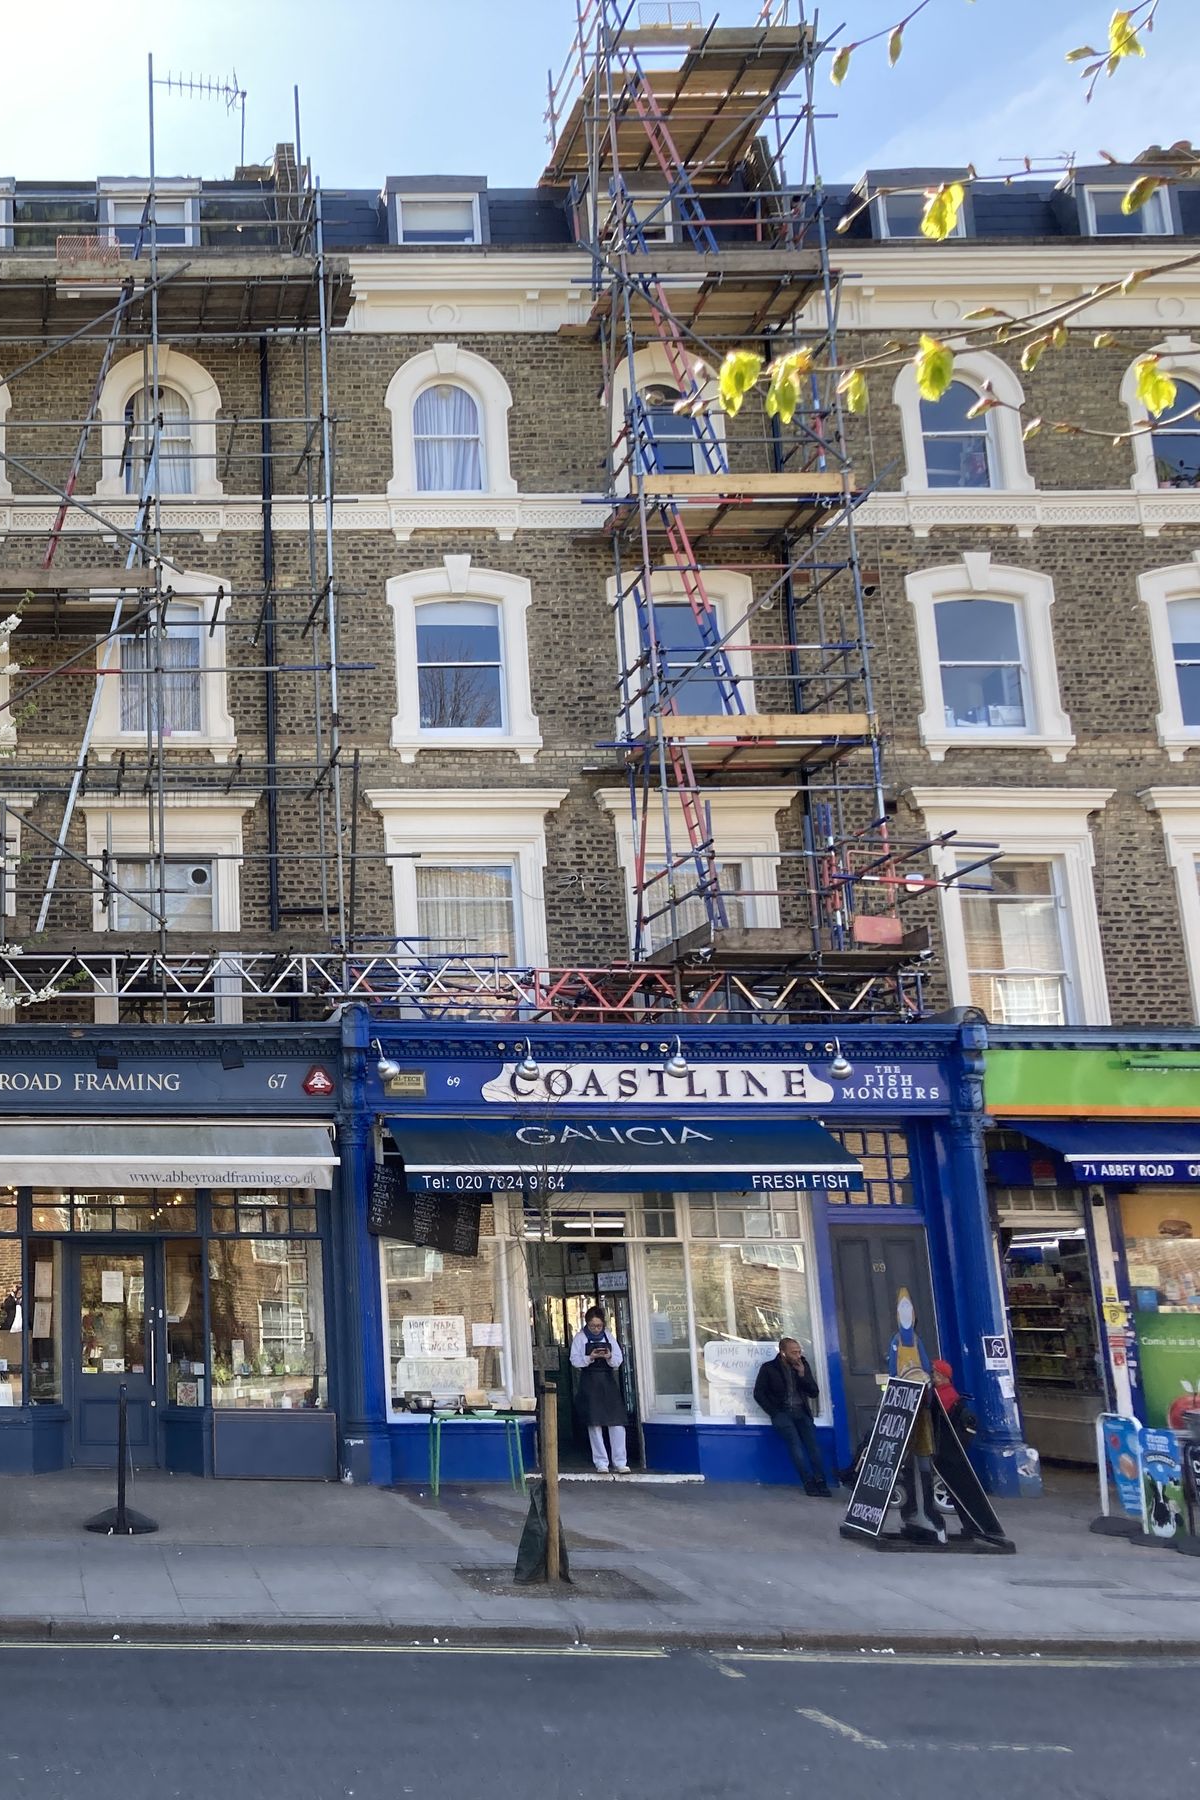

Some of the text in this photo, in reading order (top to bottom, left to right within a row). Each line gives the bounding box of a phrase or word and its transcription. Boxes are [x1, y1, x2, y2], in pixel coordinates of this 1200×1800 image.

[875, 1065, 901, 1074] THE
[73, 1073, 181, 1092] FRAMING
[267, 1073, 288, 1089] 67
[446, 1075, 461, 1088] 69
[509, 1068, 807, 1099] COASTLINE
[864, 1074, 913, 1086] FISH
[842, 1087, 940, 1099] MONGERS
[515, 1124, 714, 1146] GALICIA
[1082, 1164, 1097, 1177] 71
[1100, 1164, 1136, 1177] ABBEY
[1139, 1164, 1175, 1177] ROAD
[421, 1174, 450, 1189] Tel:
[455, 1175, 483, 1189] 020
[487, 1175, 524, 1190] 7624
[751, 1174, 849, 1189] FRESH FISH
[747, 1347, 773, 1358] MADE
